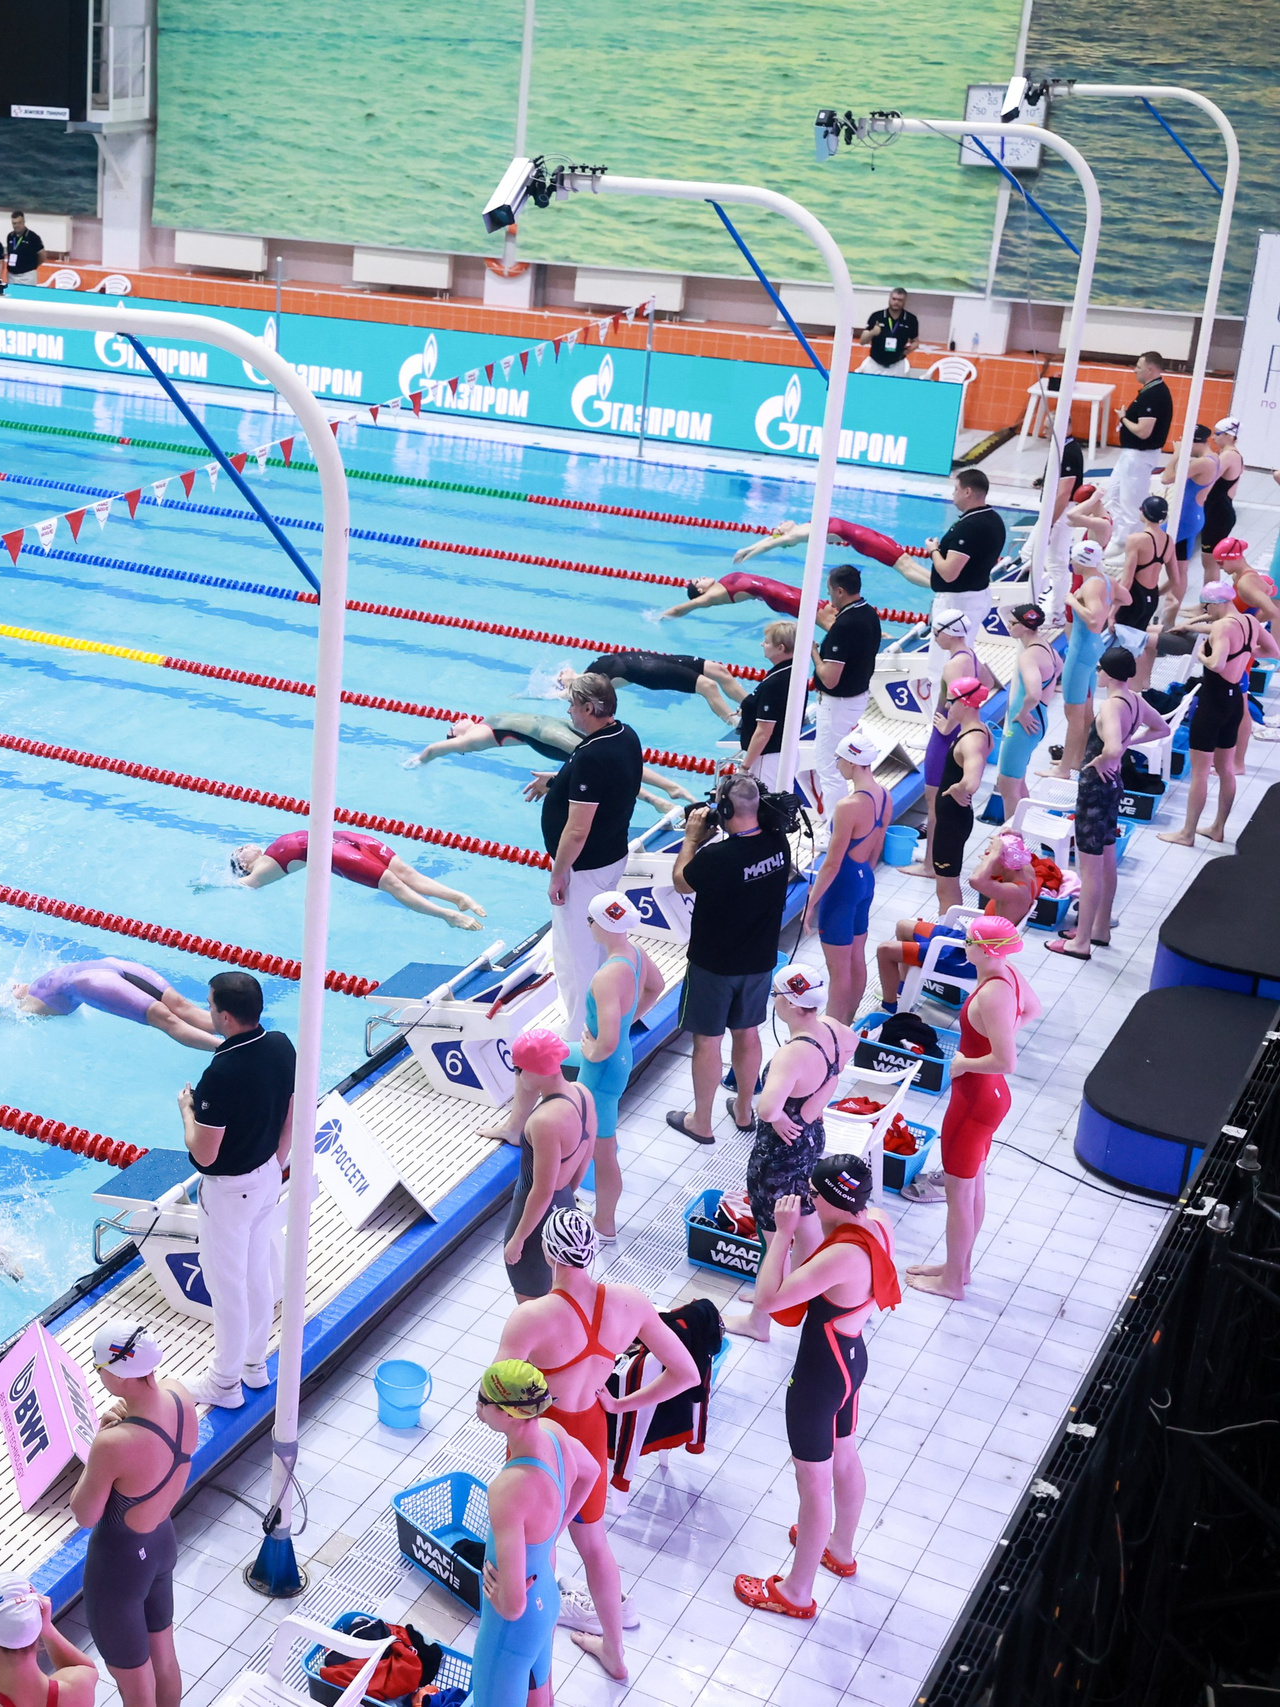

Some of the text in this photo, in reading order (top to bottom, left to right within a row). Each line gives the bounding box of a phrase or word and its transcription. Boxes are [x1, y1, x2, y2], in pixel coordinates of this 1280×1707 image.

[435, 380, 529, 418] ГАЗПРОМ
[797, 424, 907, 466] ГАПРОМ
[987, 614, 1000, 632] 2
[895, 688, 908, 706] 3
[638, 895, 653, 919] 5
[922, 979, 945, 995] AVE
[445, 1050, 463, 1076] 6
[873, 1060, 922, 1083] WAE
[331, 1143, 370, 1197] РОССЕТИ
[716, 1240, 761, 1262] MAD
[182, 1262, 201, 1292] 7
[2, 1409, 13, 1433] WATER
[14, 1387, 50, 1465] BWT
[7, 1433, 25, 1479] TECHNOLOGY
[411, 1543, 461, 1590] WAVE
[416, 1534, 454, 1572] MAD
